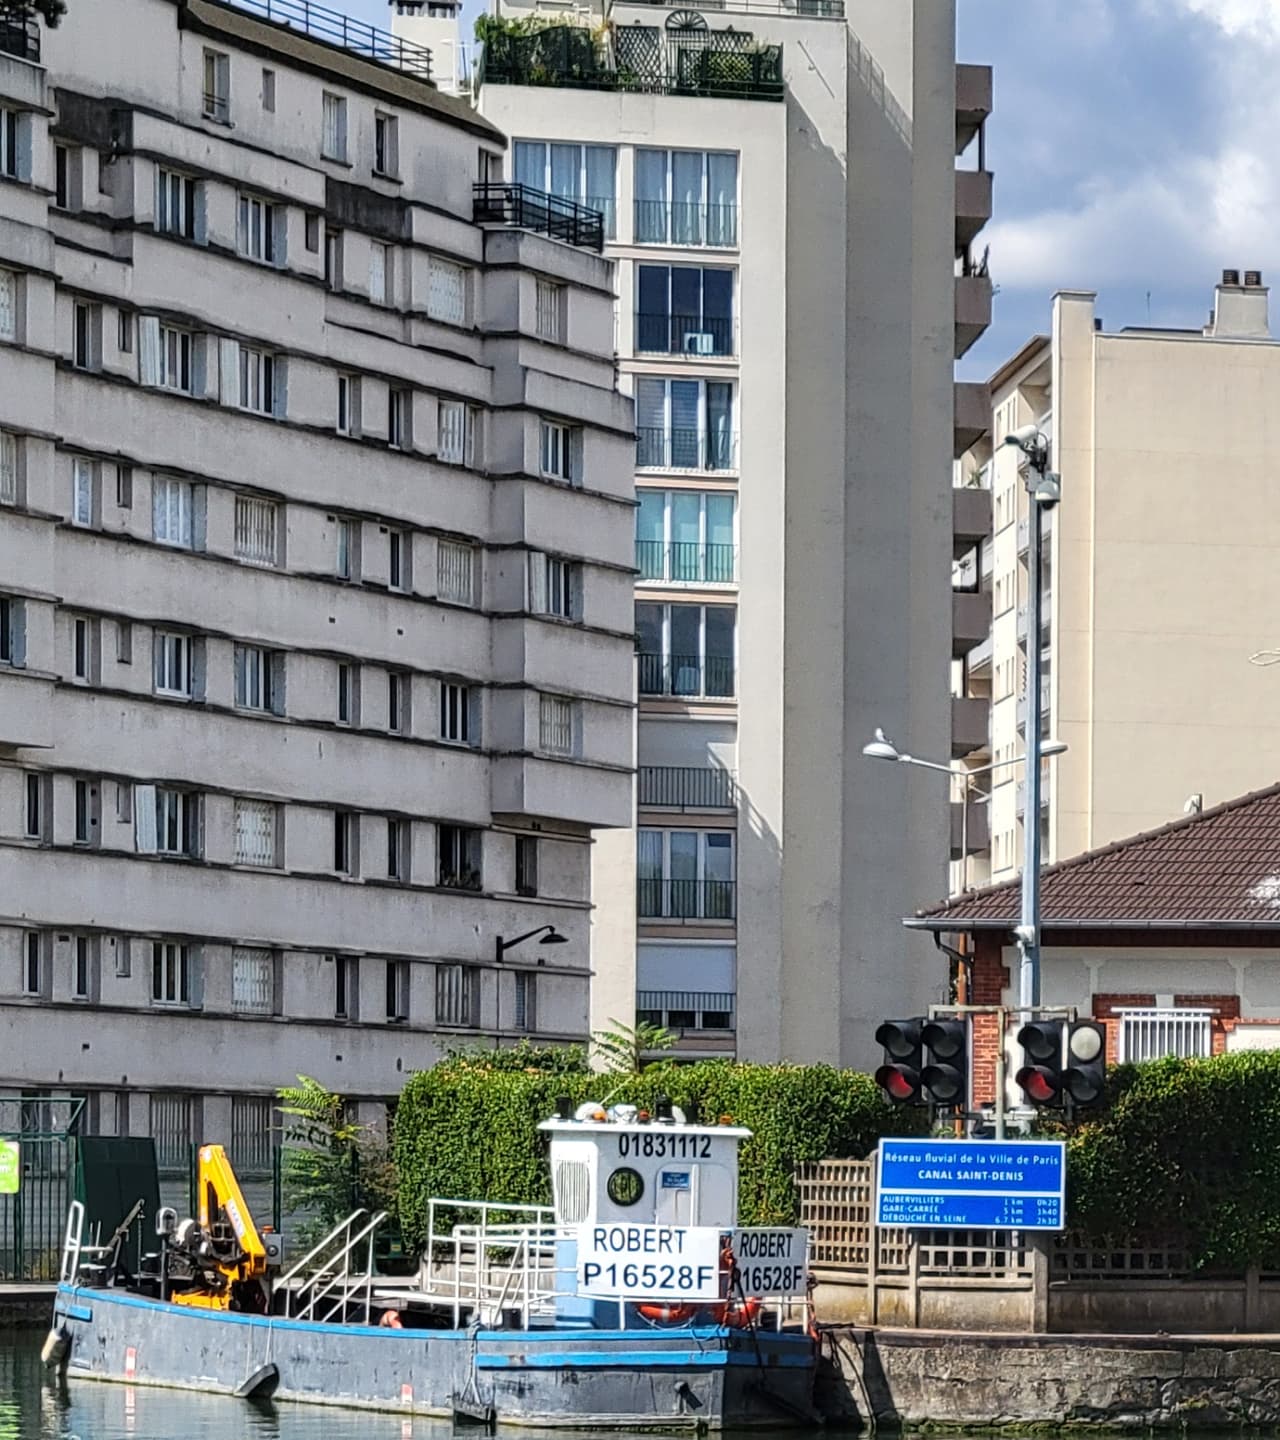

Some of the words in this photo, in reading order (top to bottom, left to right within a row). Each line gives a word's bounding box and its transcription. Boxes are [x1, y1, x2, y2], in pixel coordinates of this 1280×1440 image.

[618, 1132, 712, 1158] 01831112
[884, 1152, 922, 1163] Réseau
[925, 1153, 957, 1164] fluvial
[960, 1154, 973, 1164] de
[976, 1154, 986, 1164] la
[989, 1154, 1013, 1165] Ville
[1016, 1154, 1029, 1165] de
[1033, 1155, 1059, 1165] Paris
[918, 1169, 952, 1180] CANAL
[956, 1170, 1024, 1181] SAINT-DENIS
[882, 1195, 945, 1204] AUBERVILLIERS
[943, 1215, 966, 1223] SEINE
[593, 1227, 687, 1253] ROBERT
[739, 1232, 793, 1258] ROBERT
[583, 1262, 714, 1290] P16528F
